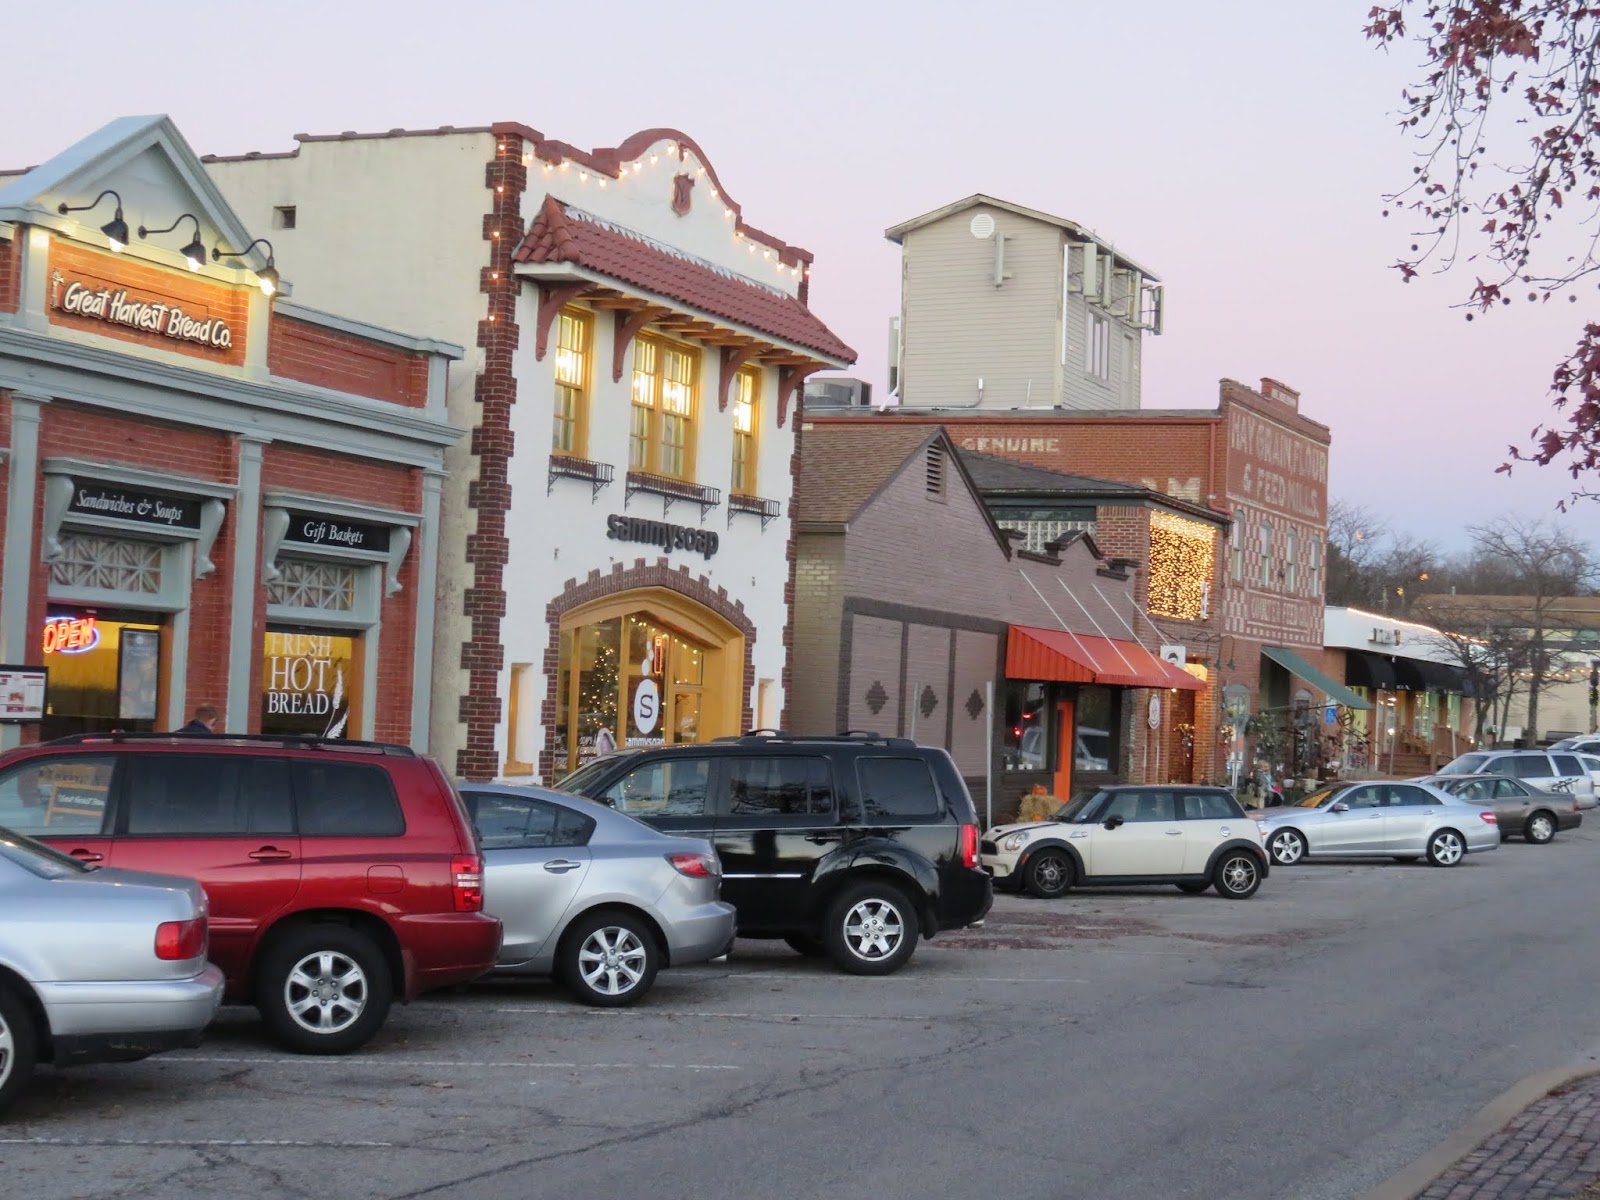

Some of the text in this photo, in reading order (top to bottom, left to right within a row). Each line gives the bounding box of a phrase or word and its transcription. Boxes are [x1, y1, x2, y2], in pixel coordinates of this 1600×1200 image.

[64, 282, 233, 348] Great Harvest Bread Co.
[962, 437, 1059, 452] GENUINE
[1231, 411, 1255, 456] HAY
[1256, 424, 1291, 470] GRAIN
[1257, 467, 1286, 507] FEED
[76, 489, 183, 525] Sandwiches & Soups
[303, 521, 364, 545] Gift Baskets
[606, 513, 719, 561] sammysoap
[42, 617, 95, 654] OPEN
[269, 632, 332, 657] FRESH
[268, 656, 331, 692] HOT
[267, 691, 330, 715] BREAD
[640, 694, 653, 719] S
